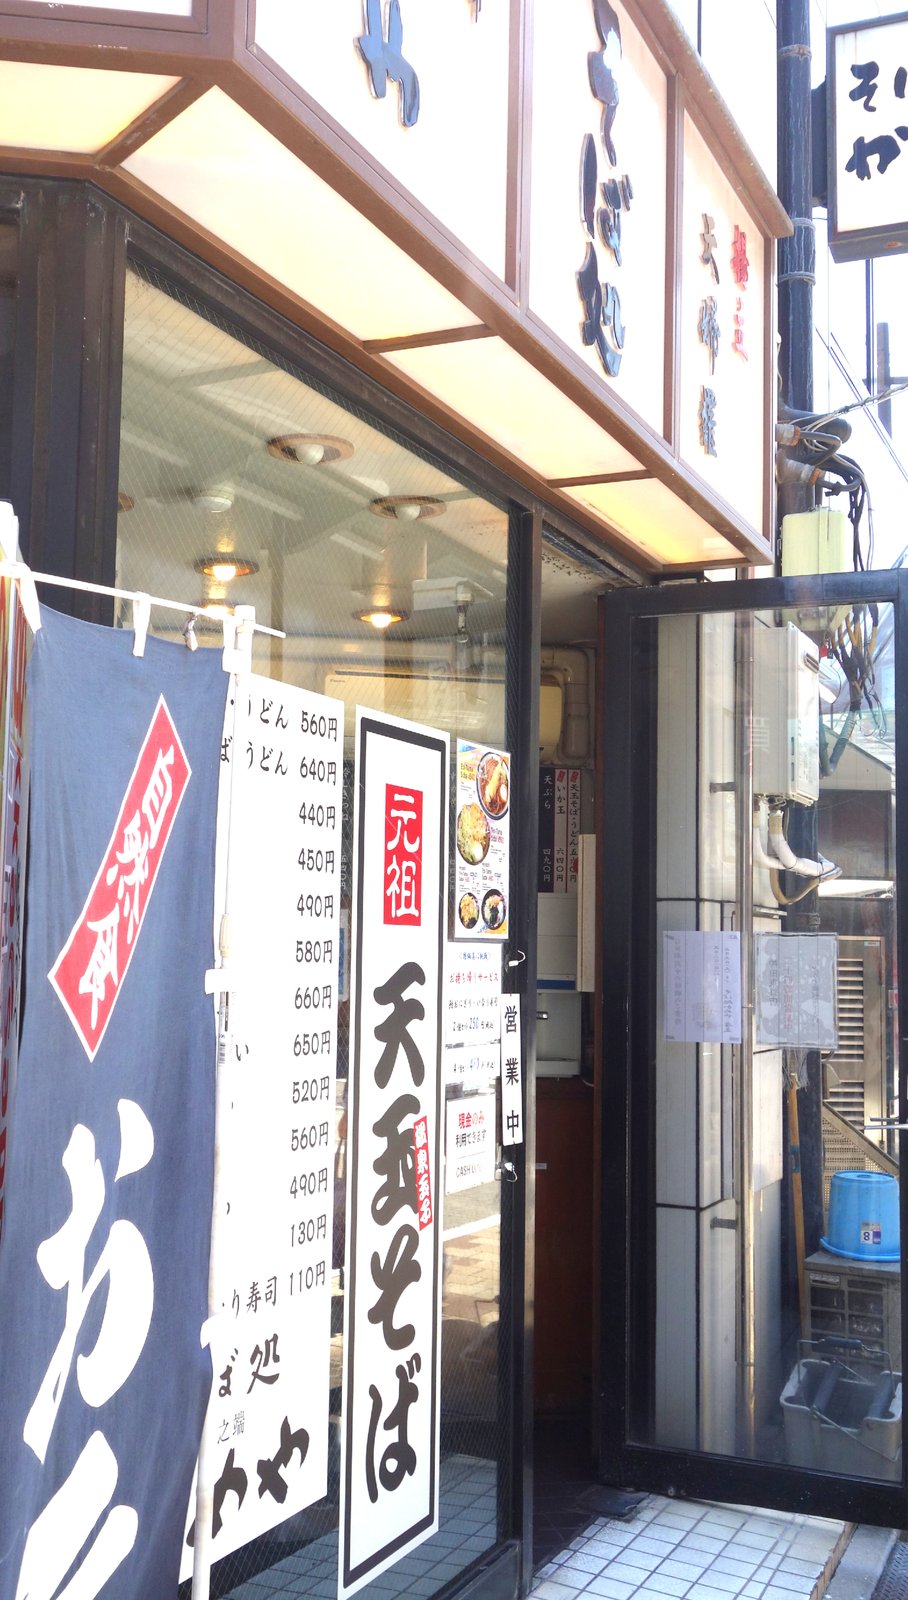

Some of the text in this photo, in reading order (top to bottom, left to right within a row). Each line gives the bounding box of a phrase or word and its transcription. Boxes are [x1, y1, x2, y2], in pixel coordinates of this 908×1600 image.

[301, 710, 338, 742] 560円
[299, 756, 337, 786] 640円
[543, 775, 553, 809] 天ぷら
[298, 802, 336, 830] 440円
[297, 848, 335, 876] 450円
[386, 793, 421, 919] 元祖
[79, 744, 175, 1030] 自然食
[296, 894, 334, 920] 490円
[295, 939, 333, 965] 580円
[294, 985, 332, 1010] 660円
[293, 1030, 331, 1057] 650円
[504, 1004, 519, 1138] 営業中
[292, 1075, 330, 1104] 520円
[458, 1110, 485, 1129] 現金のみ
[291, 1121, 329, 1151] 560円
[290, 1168, 328, 1199] 490円
[455, 1163, 471, 1179] CASH
[290, 1214, 327, 1247] 130円
[366, 961, 426, 1503] 天玉そば
[863, 1231, 871, 1242] 8
[222, 1260, 326, 1319] り寿司 110円
